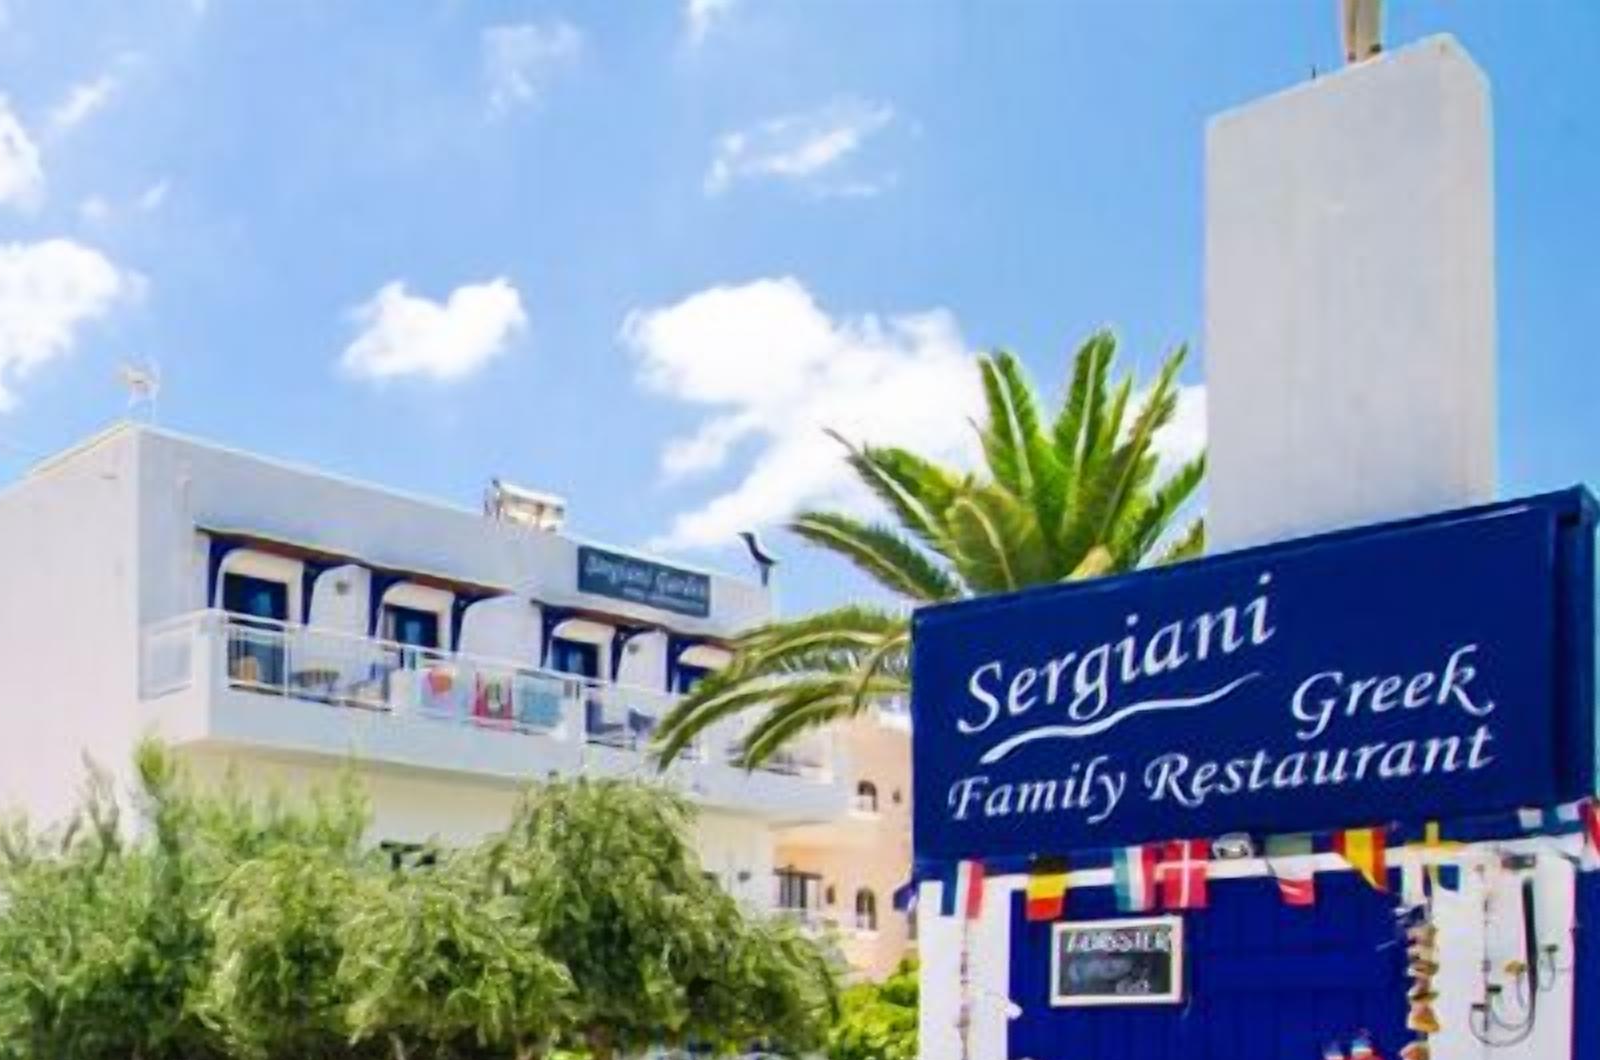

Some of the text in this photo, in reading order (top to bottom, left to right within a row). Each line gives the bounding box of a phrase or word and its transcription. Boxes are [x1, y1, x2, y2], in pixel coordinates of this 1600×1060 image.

[957, 572, 1277, 735] Sergiani
[1291, 644, 1495, 741] Greek
[948, 725, 1496, 824] Family Restaurant
